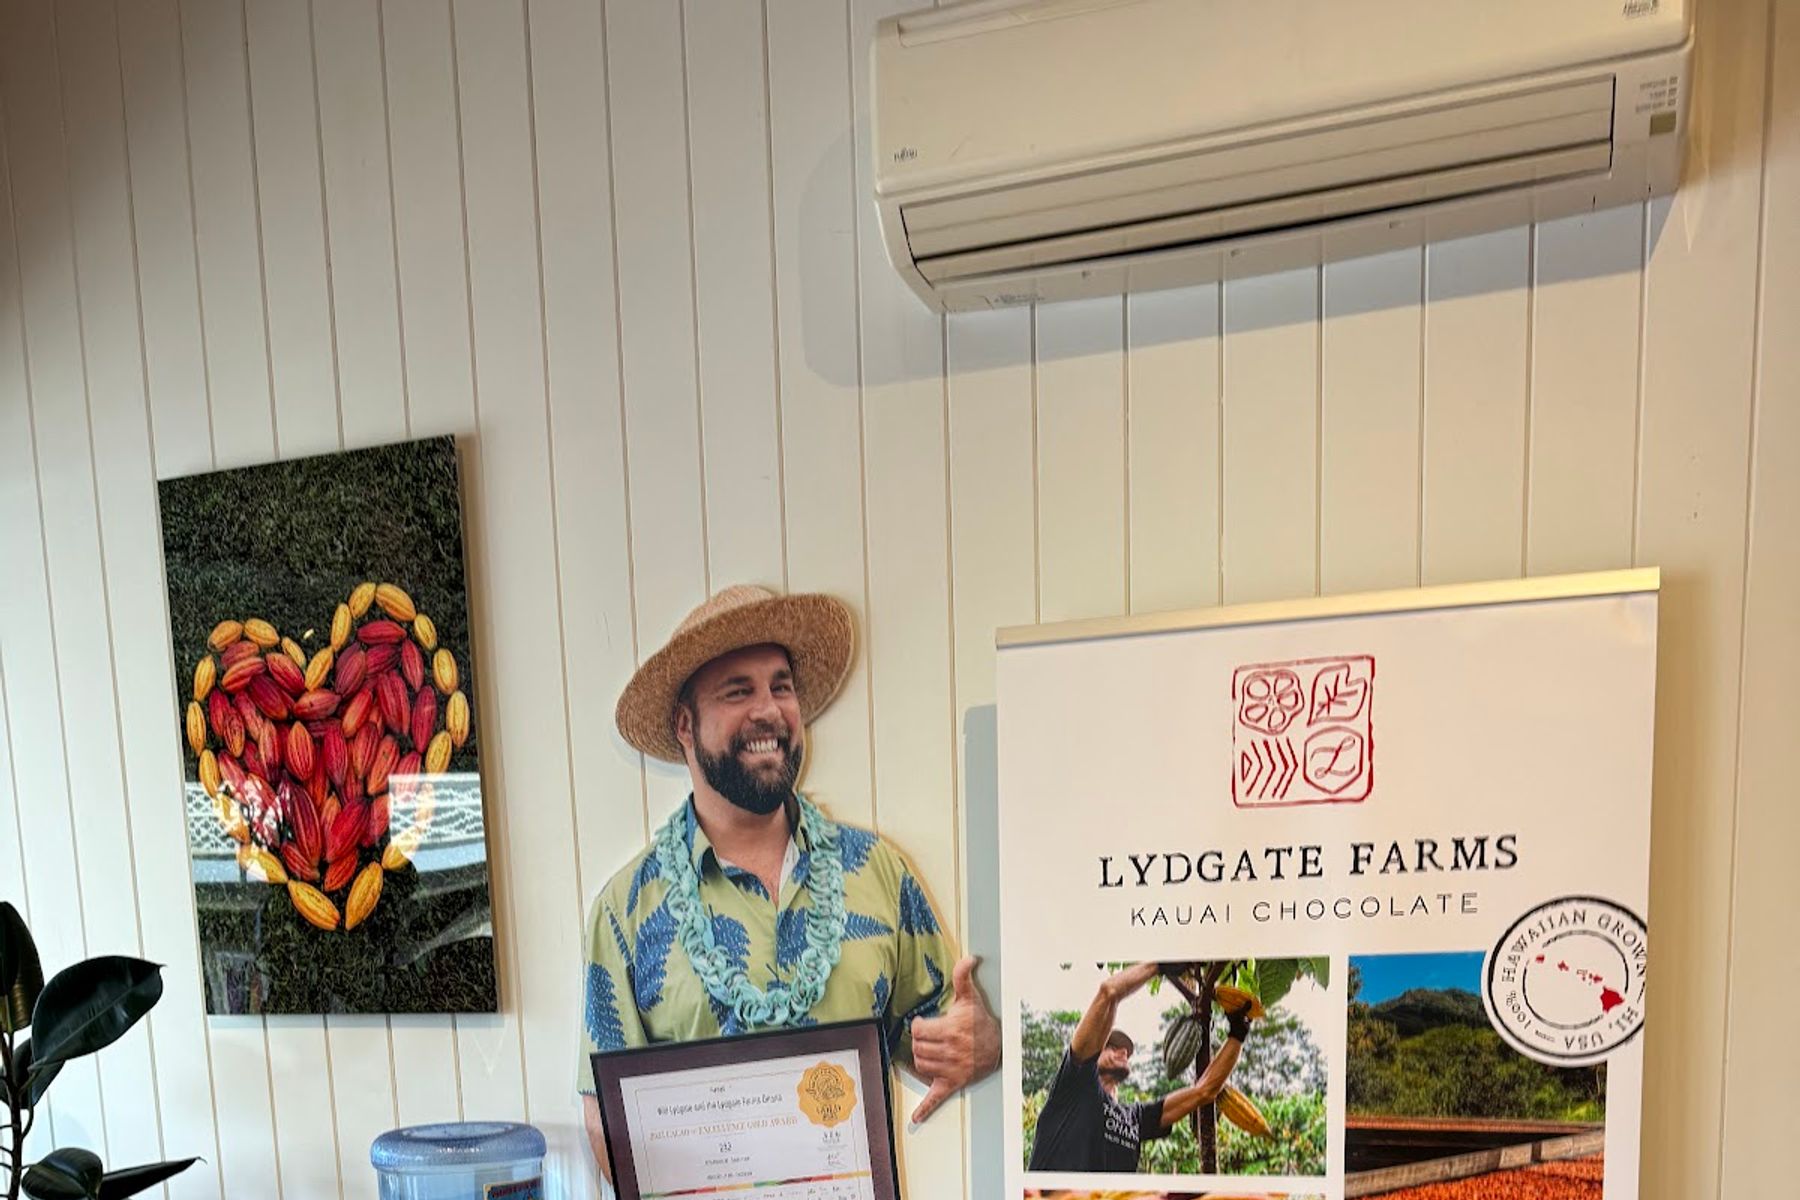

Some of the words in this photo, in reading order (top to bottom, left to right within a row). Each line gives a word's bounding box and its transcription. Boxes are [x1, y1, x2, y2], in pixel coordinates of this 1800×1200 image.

[1098, 845, 1323, 888] LYDGATE
[1349, 834, 1518, 876] FARMS
[1131, 903, 1231, 927] KAUAI
[1252, 892, 1479, 922] CHOCOLATE
[1502, 909, 1587, 983] HAWAIIAN
